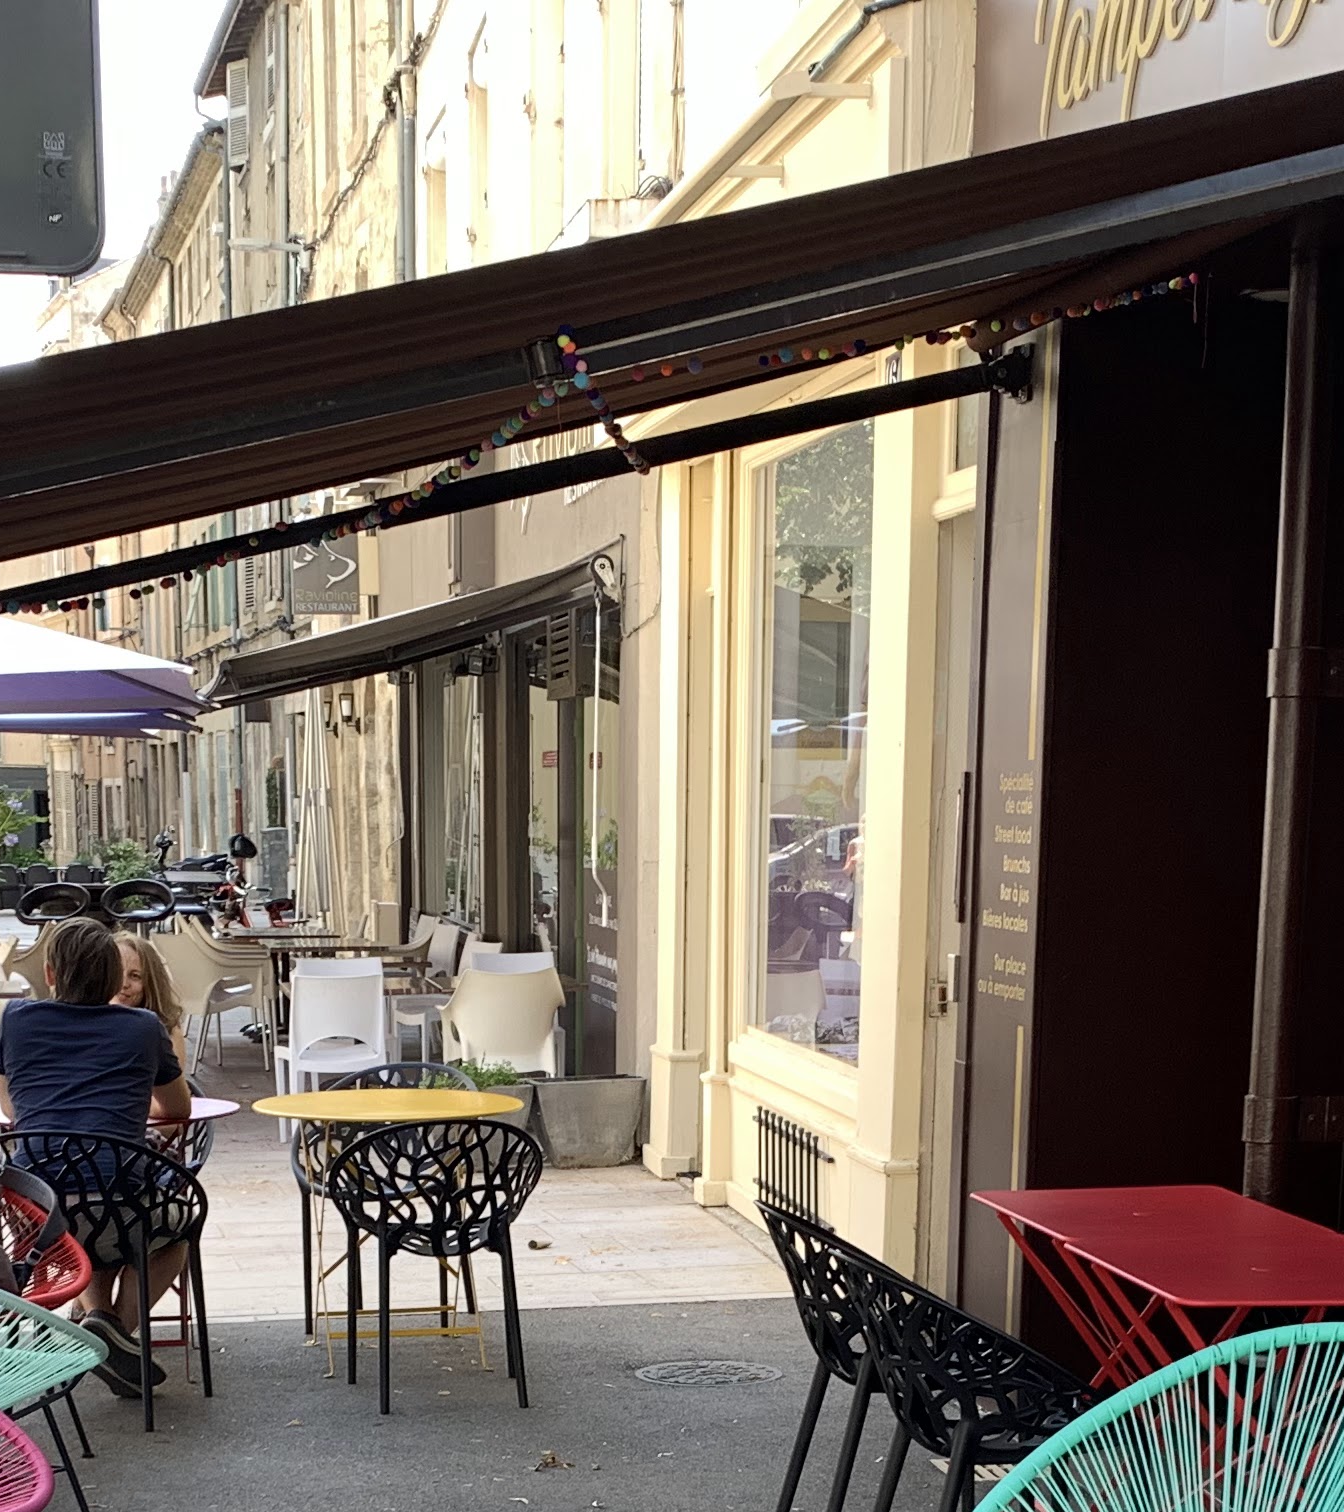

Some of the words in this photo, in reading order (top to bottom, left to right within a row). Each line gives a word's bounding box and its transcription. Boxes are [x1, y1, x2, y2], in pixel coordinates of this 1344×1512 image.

[295, 588, 358, 601] Ravioline
[296, 602, 357, 612] RESTAURANT
[1005, 796, 1015, 815] de
[1016, 795, 1033, 815] café
[1003, 854, 1031, 874] Brunchs
[1000, 883, 1011, 901] Bar
[1012, 882, 1018, 901] à
[1018, 885, 1030, 907] jus
[982, 907, 1002, 929] Bières
[1003, 912, 1028, 934] locales
[994, 953, 1005, 971] Sur
[1005, 956, 1026, 977] place
[978, 979, 987, 993] ou
[988, 975, 994, 994] à
[994, 983, 1025, 1001] emporter
